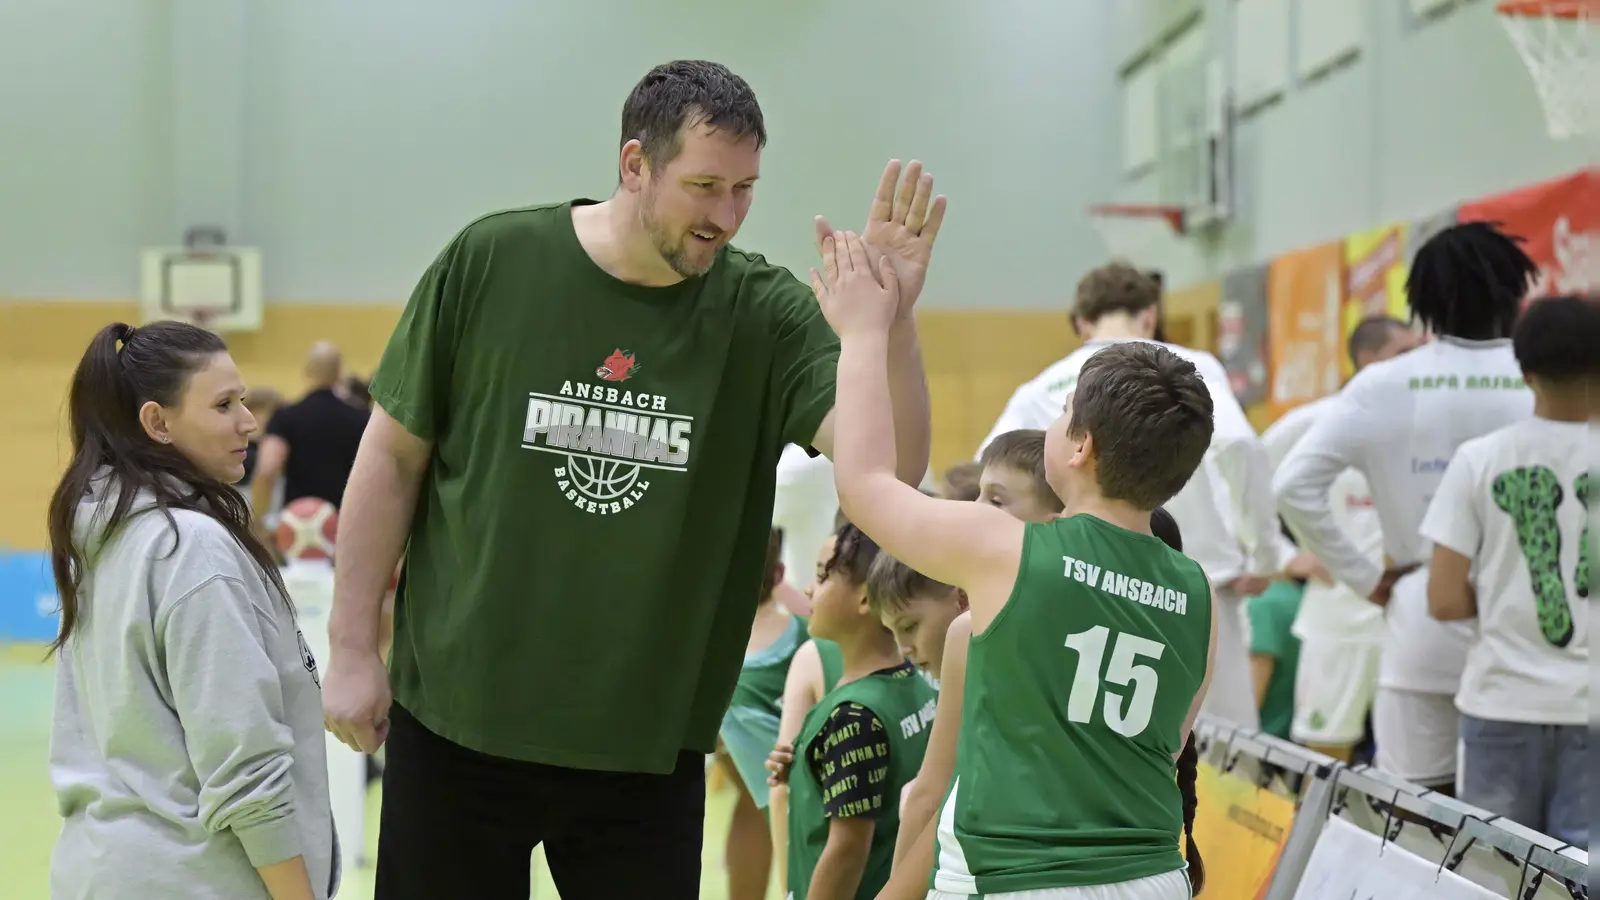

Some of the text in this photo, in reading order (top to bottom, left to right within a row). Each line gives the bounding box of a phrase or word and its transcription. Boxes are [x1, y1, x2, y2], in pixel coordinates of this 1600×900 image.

[560, 380, 667, 411] ANSBACH
[523, 397, 692, 465] PIRANHAS
[554, 466, 650, 515] BASKETBALL
[1062, 555, 1188, 616] TSV ANSBACH
[1063, 624, 1166, 738] 15
[900, 713, 921, 739] TSV
[841, 745, 874, 768] WHAT?
